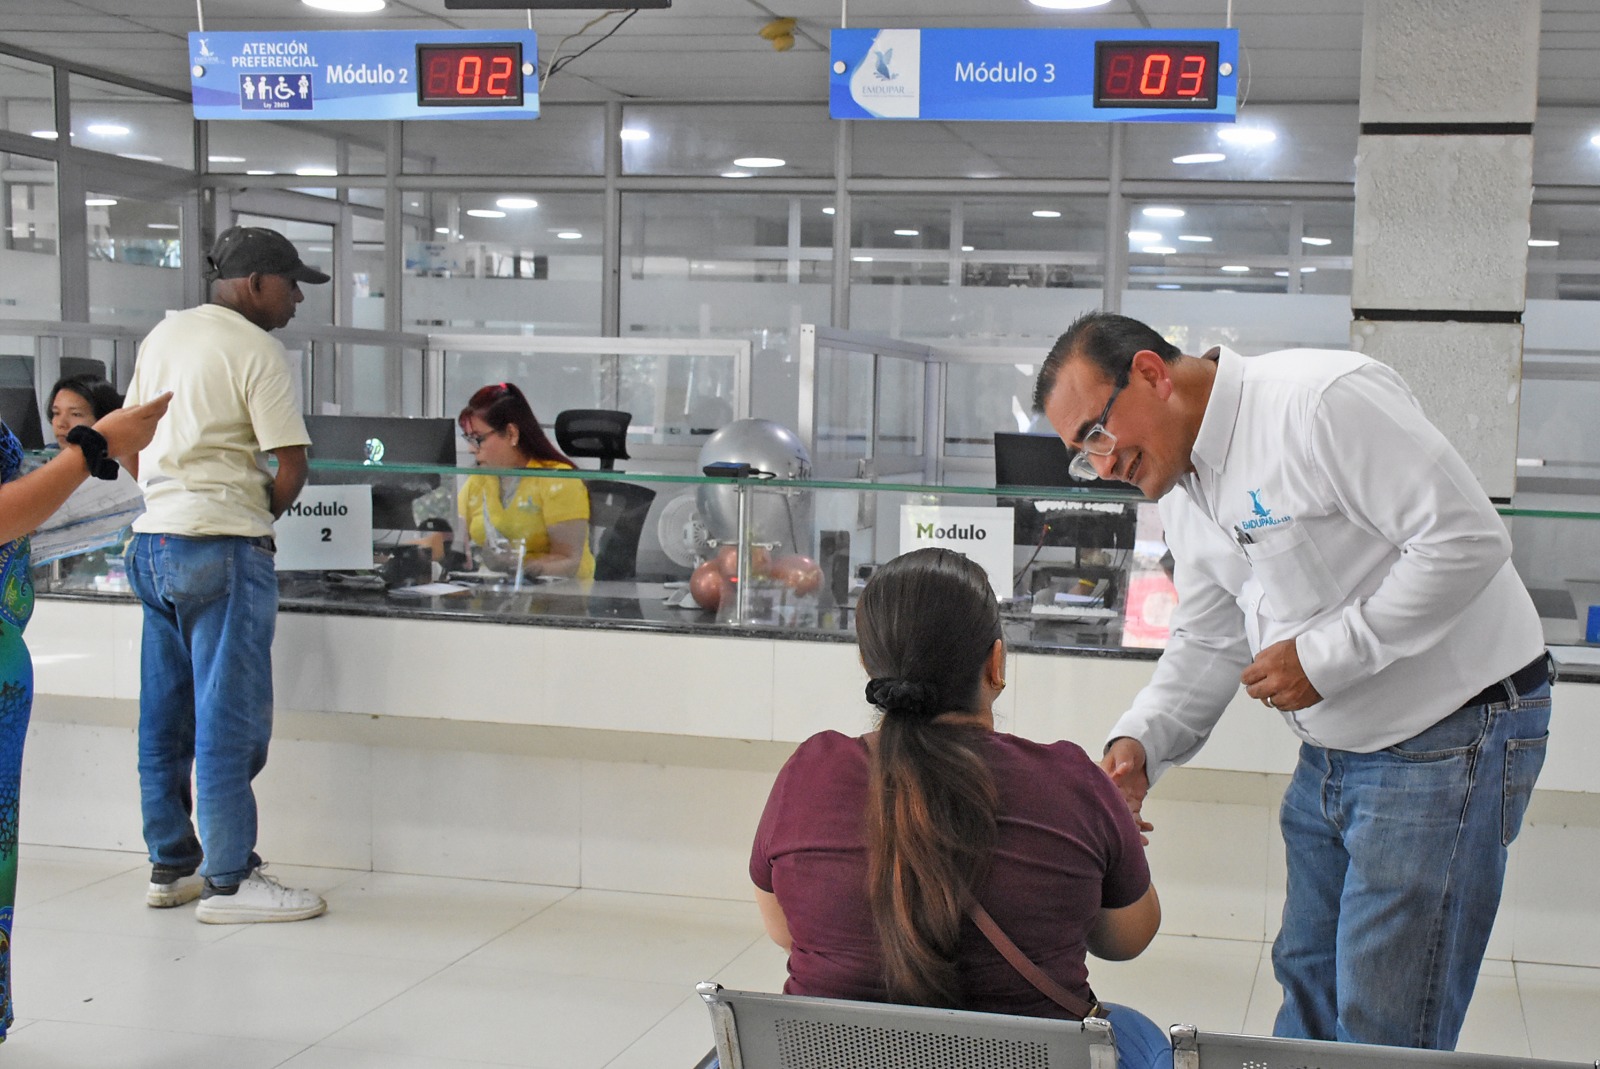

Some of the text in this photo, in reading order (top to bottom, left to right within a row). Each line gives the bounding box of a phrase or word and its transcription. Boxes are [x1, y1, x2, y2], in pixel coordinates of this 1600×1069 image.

[242, 40, 308, 55] ATENCIÓN
[231, 56, 319, 68] PREFERENCIAL
[326, 63, 408, 84] Módulo 2
[456, 56, 513, 95] 02
[954, 61, 1056, 83] Módulo 3
[1139, 54, 1206, 95] 03
[287, 501, 348, 516] Modulo
[1241, 516, 1274, 530] EMDUPAR
[321, 528, 332, 542] 2
[916, 523, 987, 540] Modulo
